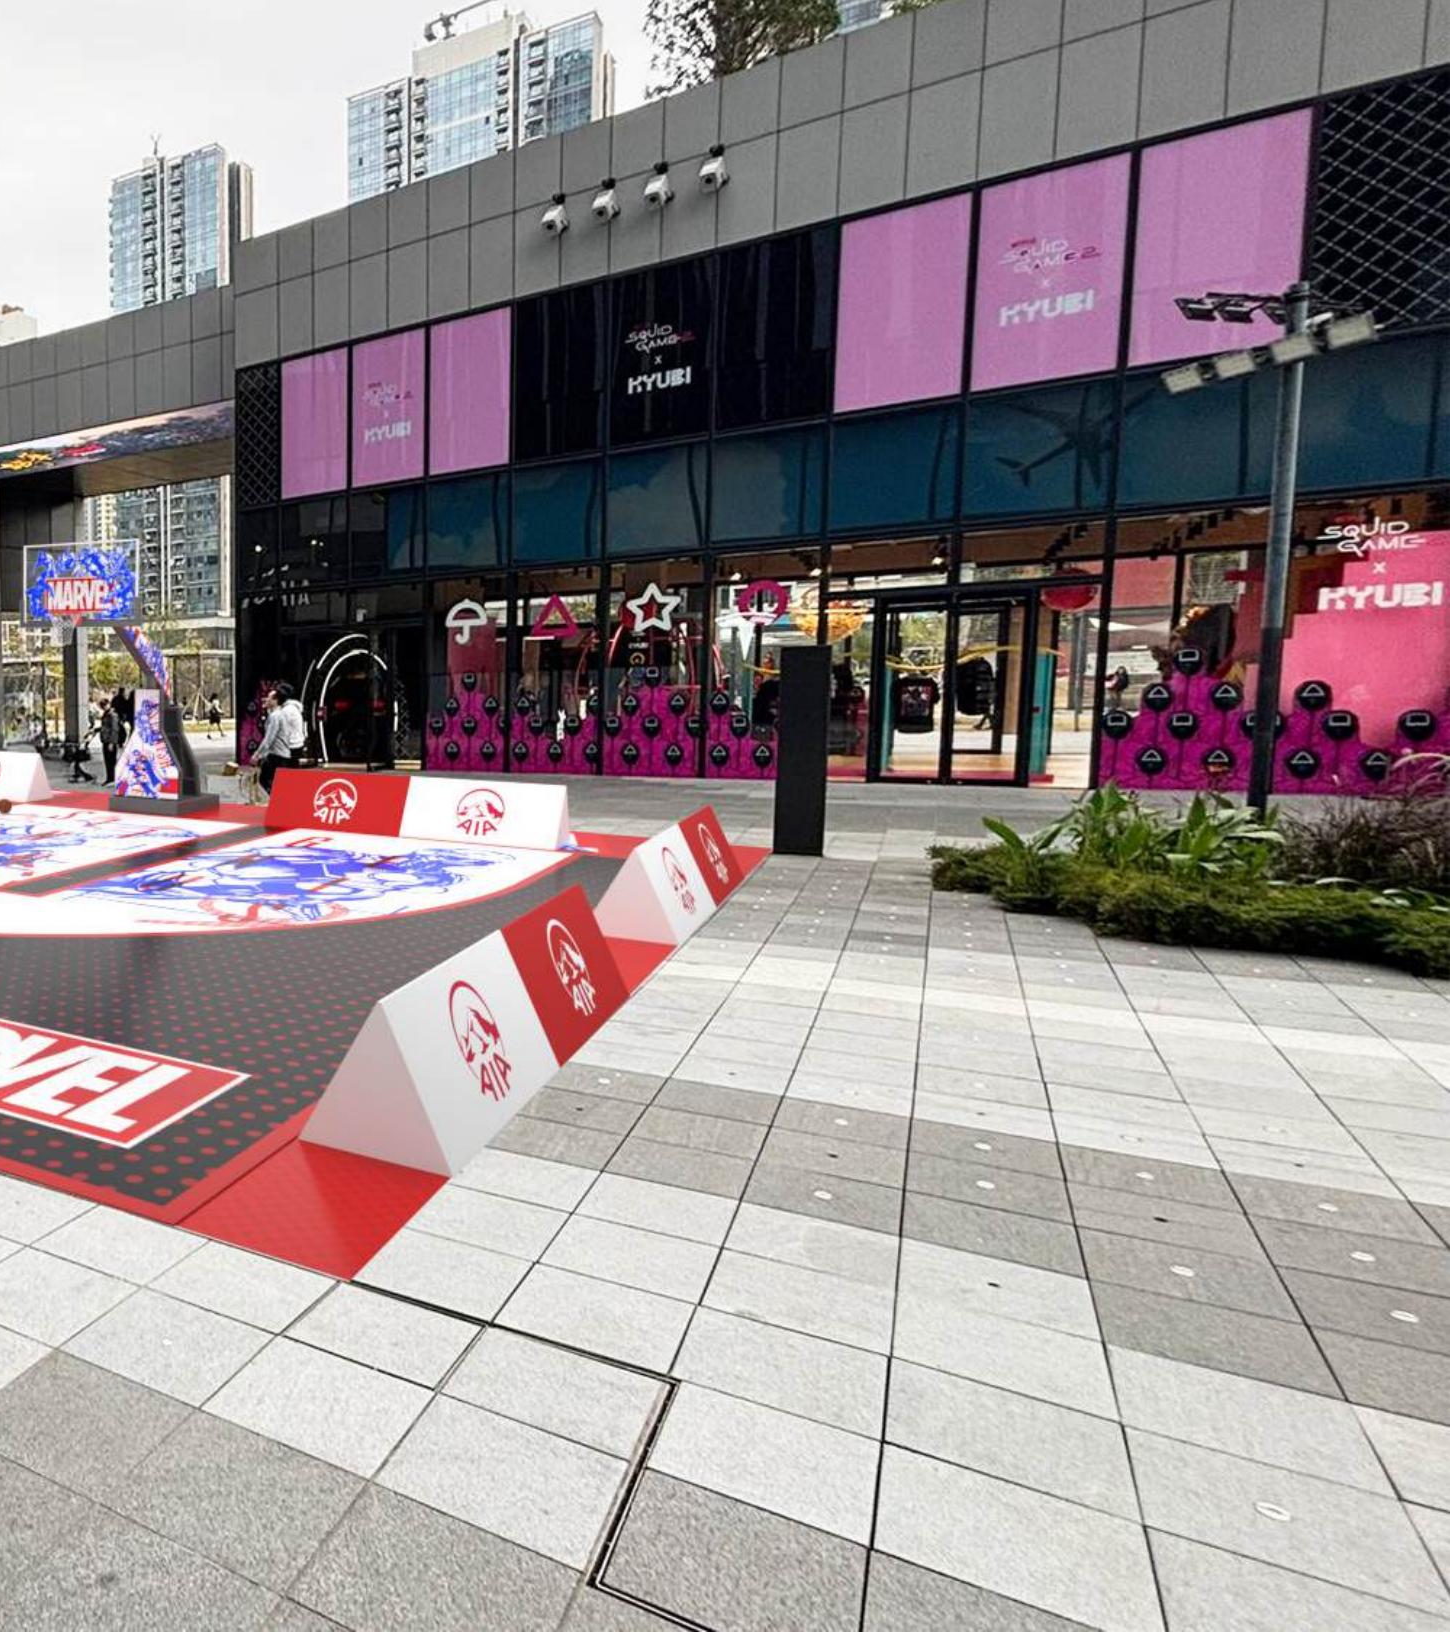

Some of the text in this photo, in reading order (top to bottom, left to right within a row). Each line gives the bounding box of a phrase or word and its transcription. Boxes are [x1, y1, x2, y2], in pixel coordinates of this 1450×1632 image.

[999, 289, 1095, 327] KYUBI
[625, 323, 673, 344] SQUID
[627, 366, 692, 394] KYUBI
[364, 421, 412, 445] KYUBI
[1316, 516, 1410, 542] SQUID
[1337, 534, 1427, 557] GAME
[1317, 581, 1444, 611] KYUBI
[313, 806, 351, 825] AIA
[456, 817, 498, 836] AIA
[572, 977, 596, 1017] AIA
[480, 1052, 512, 1102] AIA
